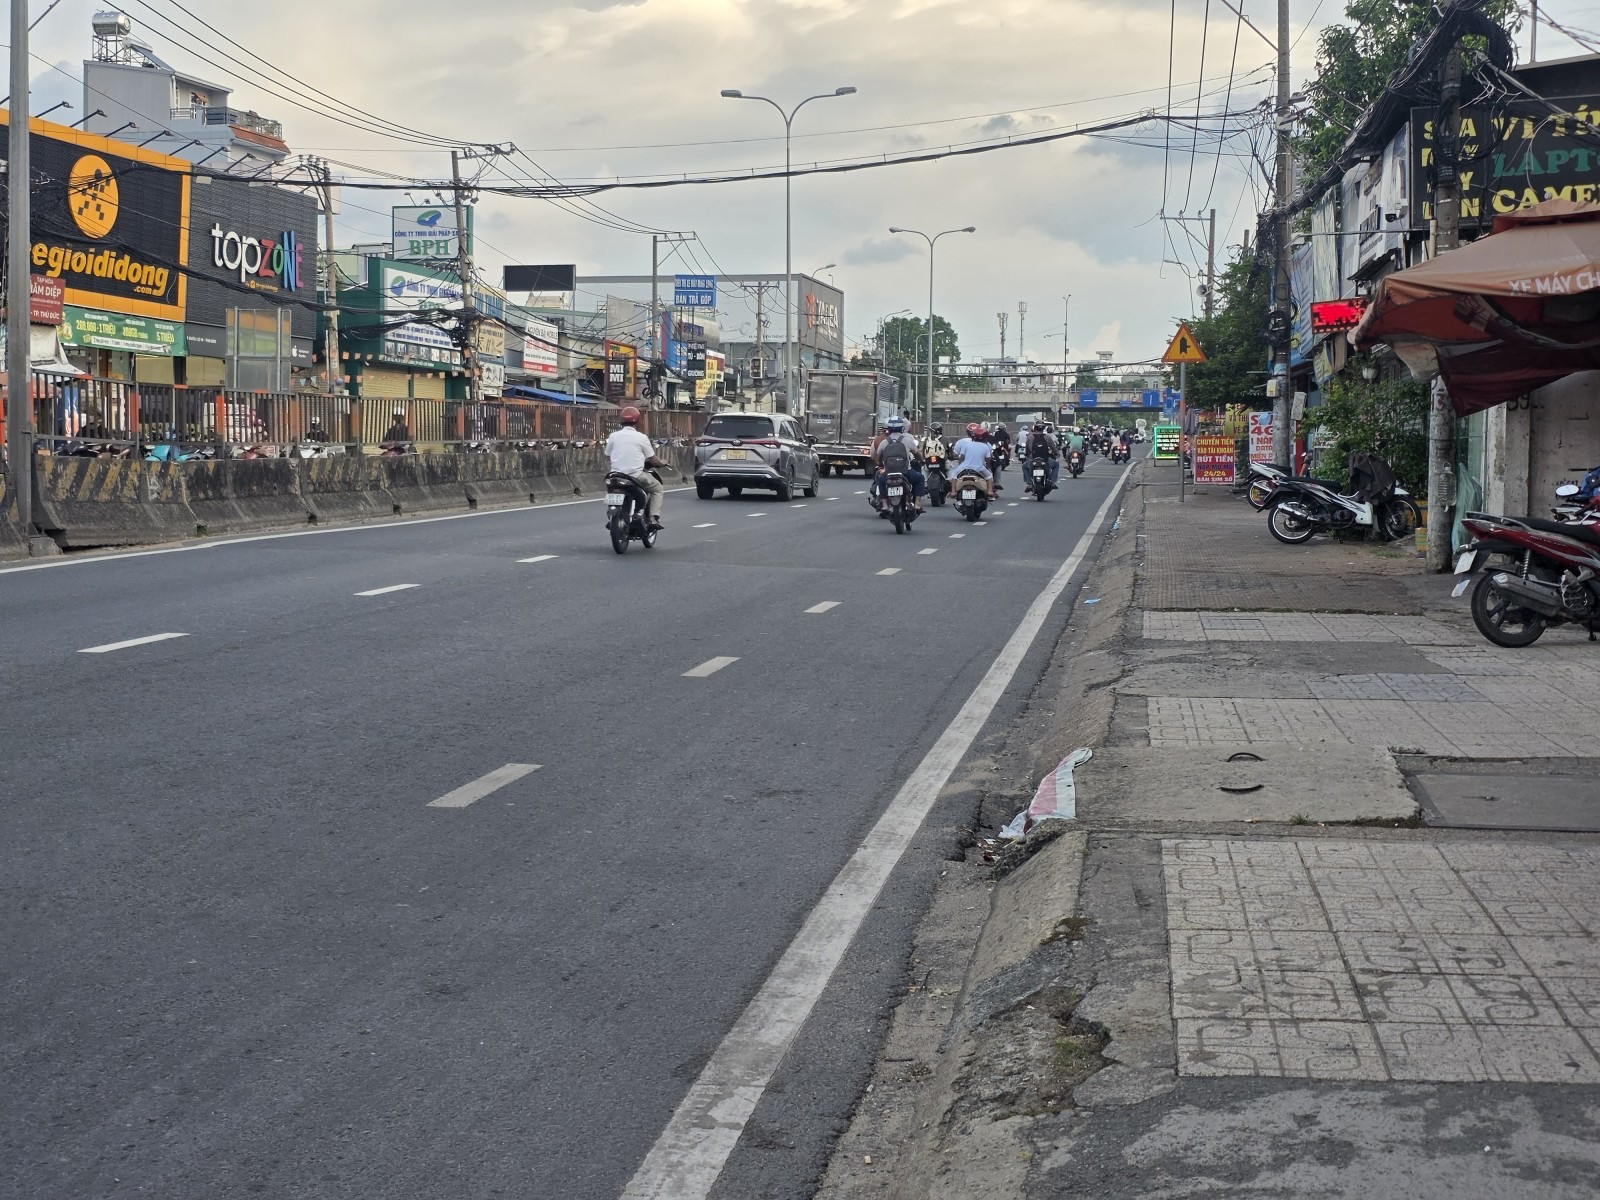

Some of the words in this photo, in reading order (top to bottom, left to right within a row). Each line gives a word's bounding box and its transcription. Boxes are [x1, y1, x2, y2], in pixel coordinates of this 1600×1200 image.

[1492, 148, 1600, 177] LAPT
[1492, 184, 1600, 213] CAME
[408, 239, 451, 256] BPH
[30, 242, 169, 296] egioididong
[45, 285, 62, 299] DIỆP
[1534, 271, 1572, 294] MÁY
[688, 292, 699, 305] TRẢ
[1197, 455, 1213, 463] RÚT
[1215, 454, 1234, 463] TIỀN
